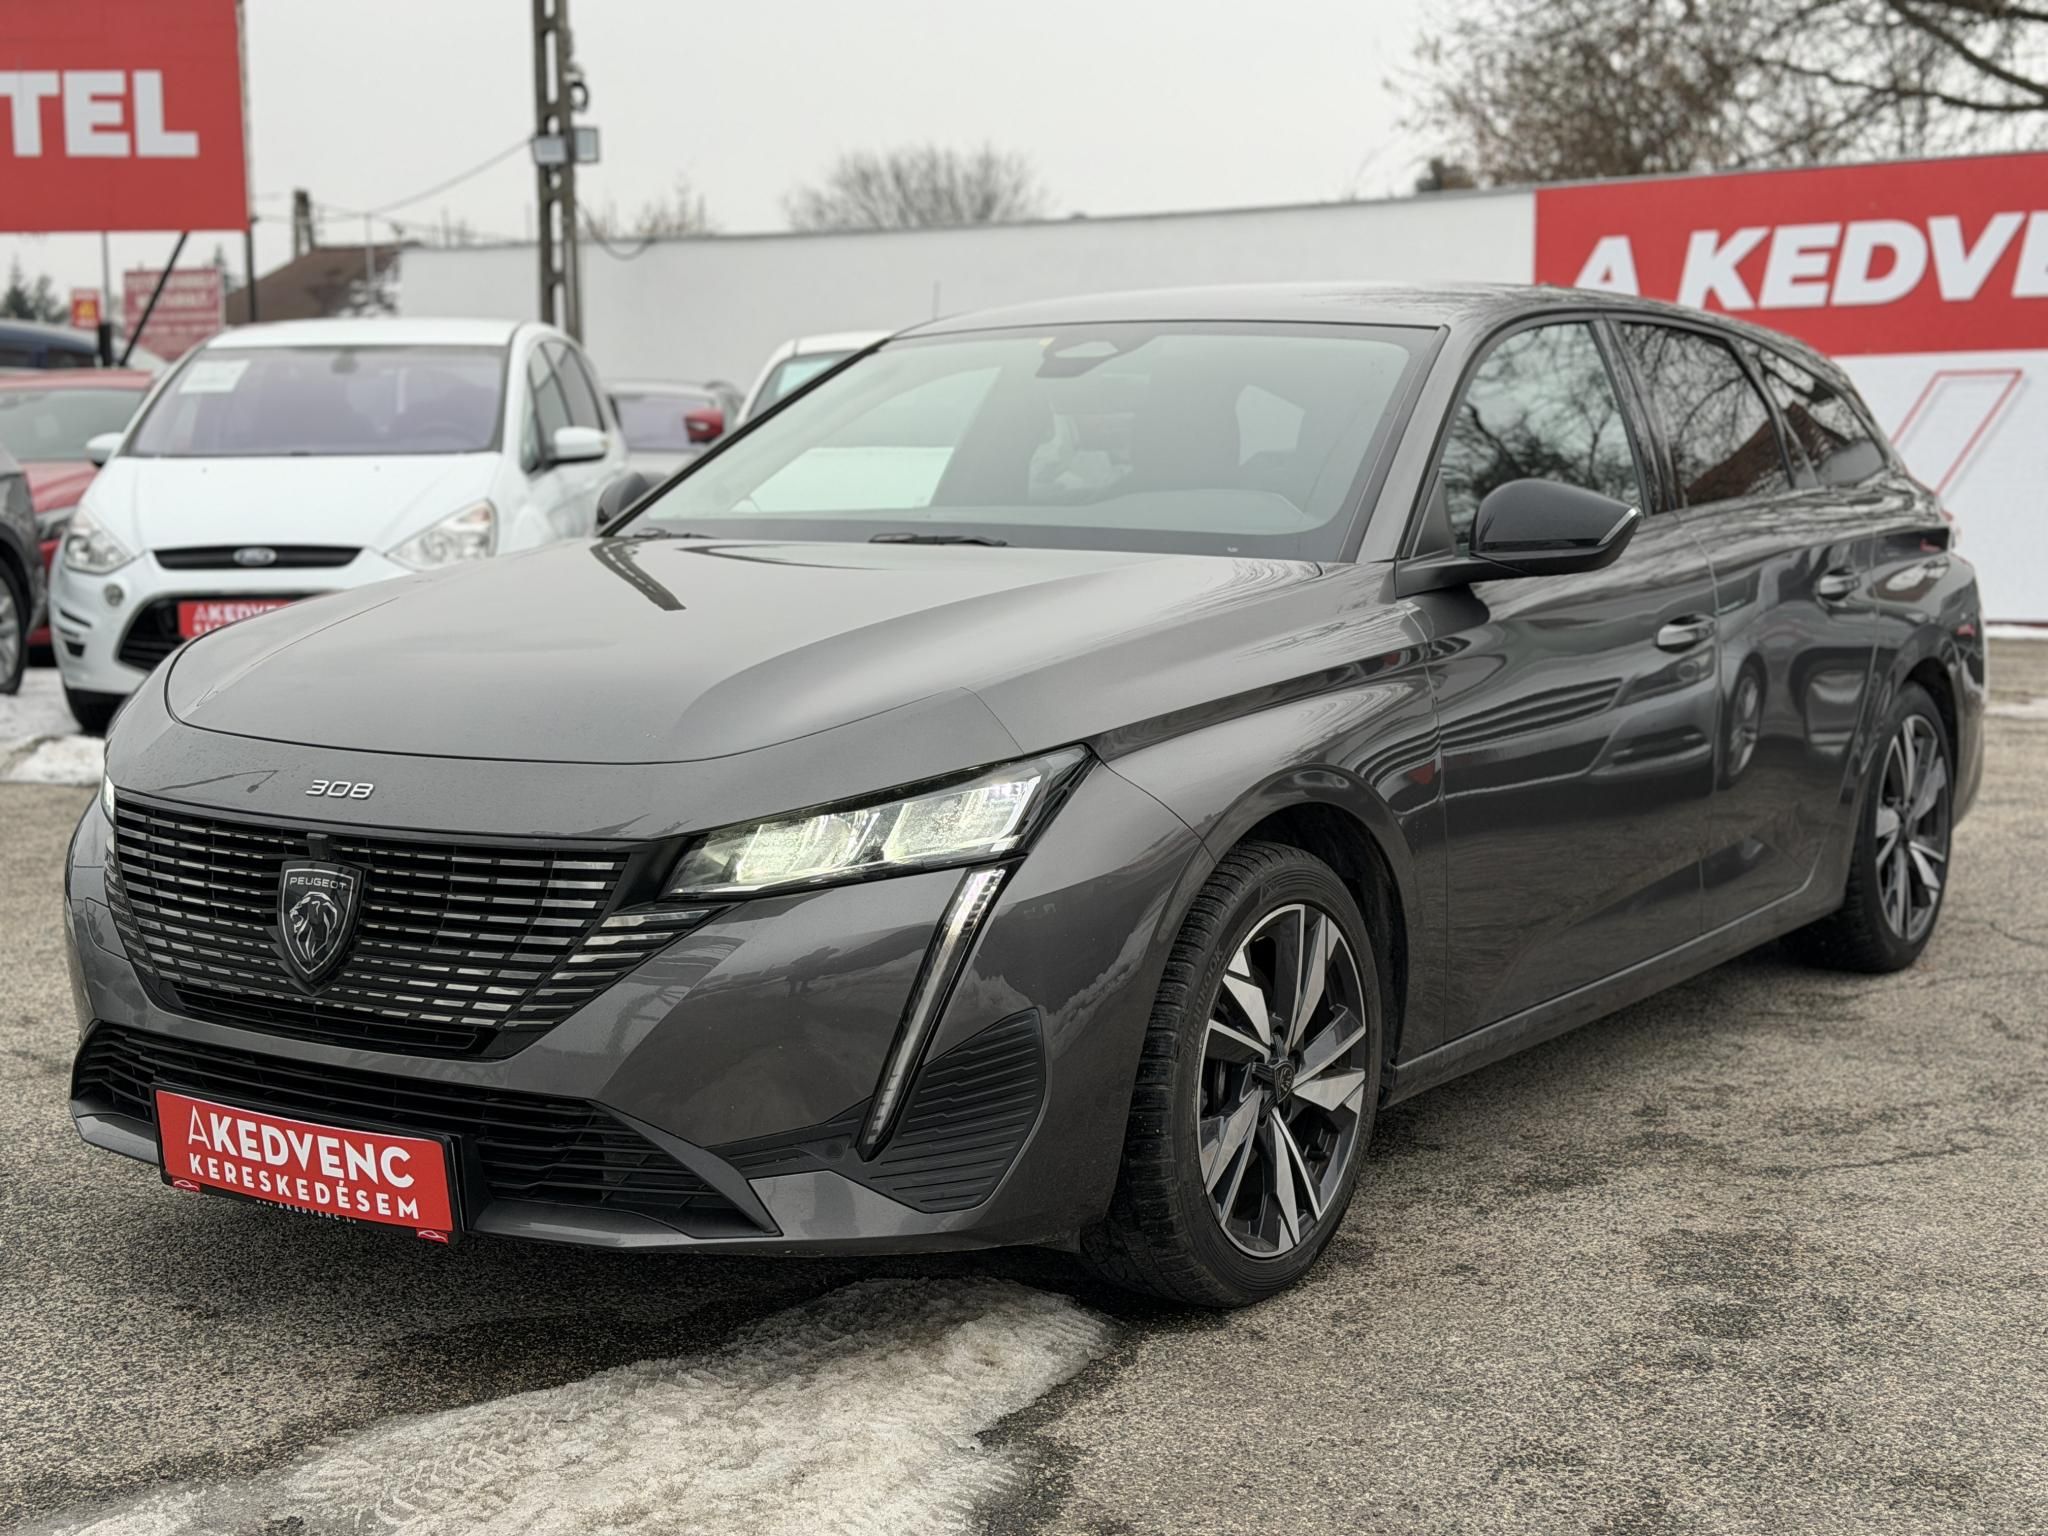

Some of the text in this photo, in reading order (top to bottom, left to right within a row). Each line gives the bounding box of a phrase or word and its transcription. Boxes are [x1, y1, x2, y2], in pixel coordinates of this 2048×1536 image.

[0, 70, 199, 157] TEL
[1574, 236, 1640, 296] A
[305, 779, 374, 799] 308
[289, 876, 347, 889] PEUGEOT
[188, 1105, 415, 1188] AKEDVENC
[189, 1153, 419, 1220] KERESKEDÉSEM
